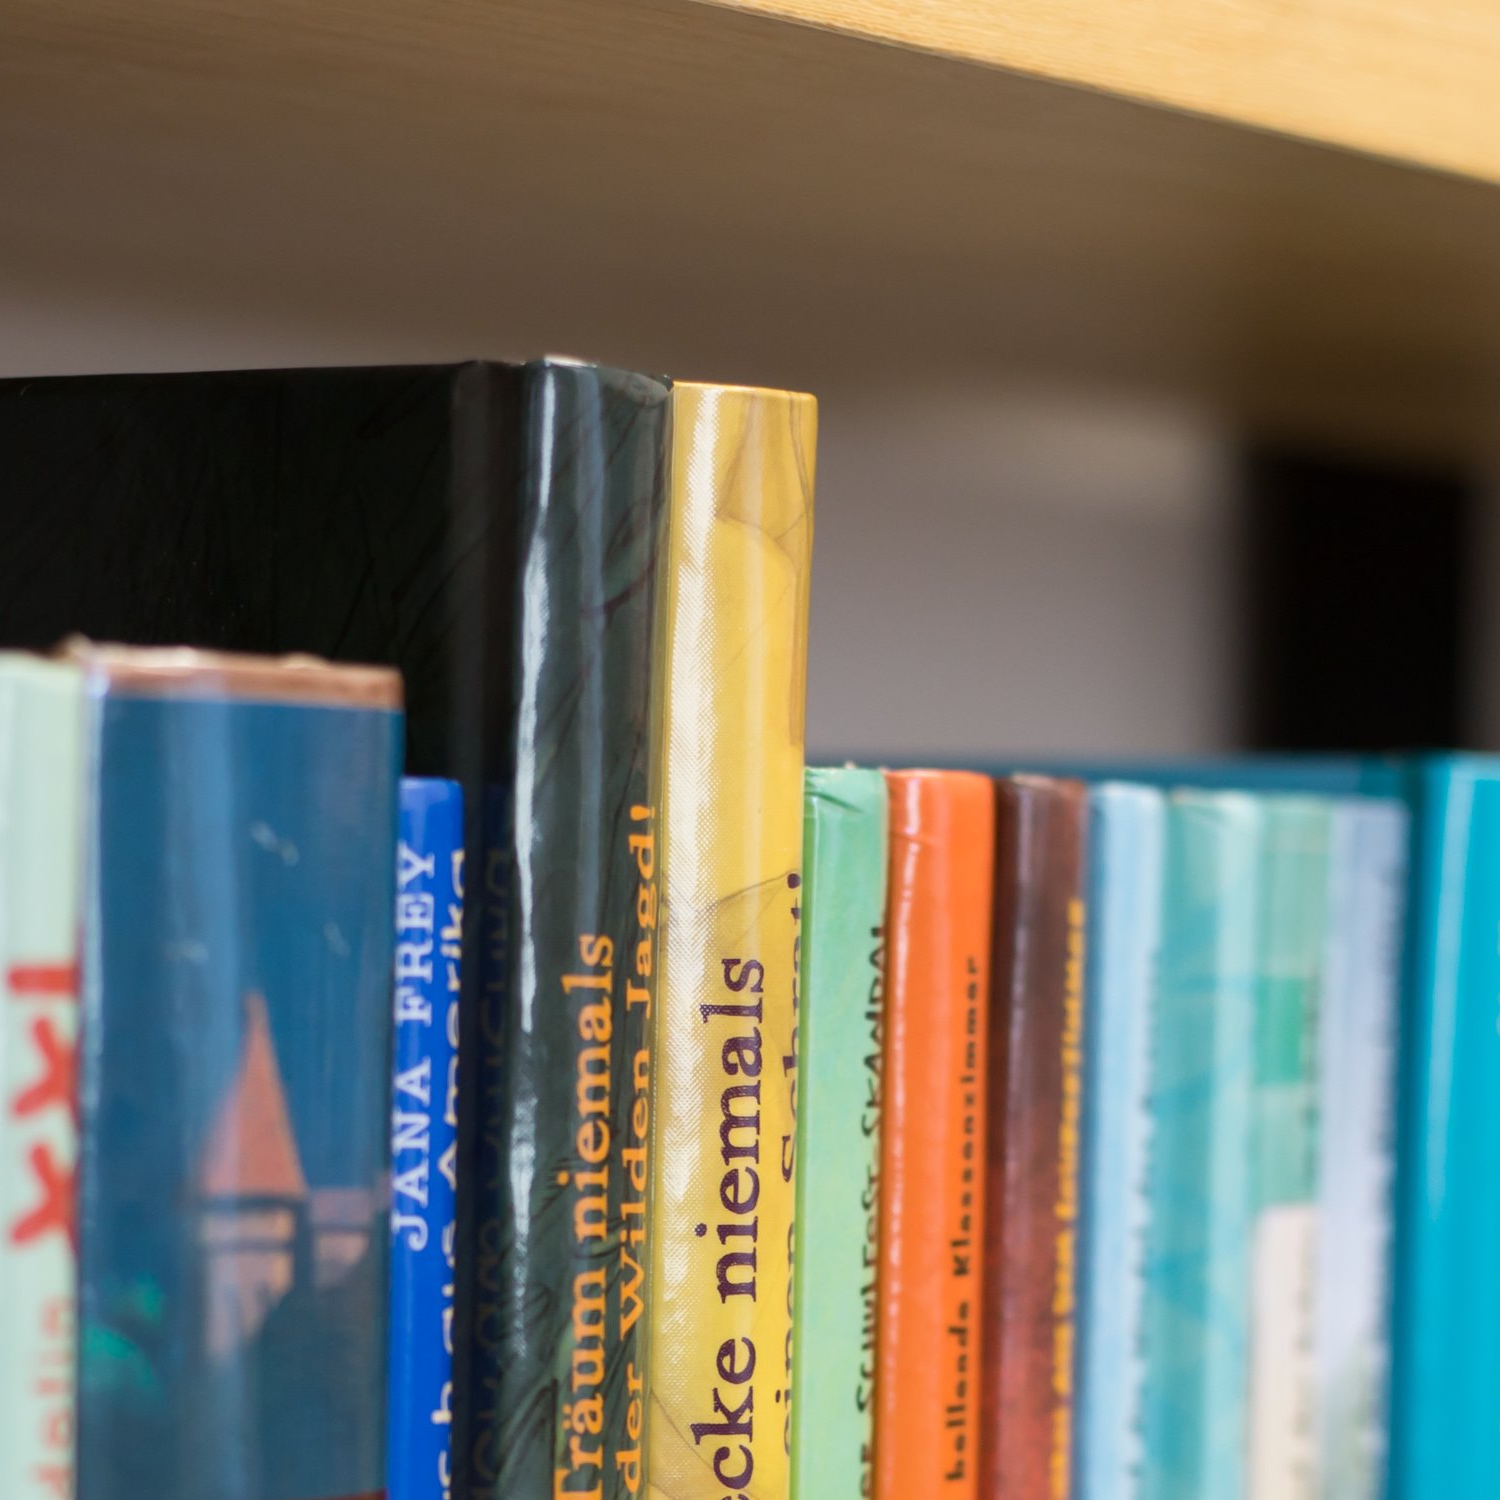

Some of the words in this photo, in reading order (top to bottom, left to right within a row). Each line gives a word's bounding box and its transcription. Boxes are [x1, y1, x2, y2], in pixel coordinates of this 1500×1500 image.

[394, 839, 435, 1027] FREY
[626, 804, 657, 1019] Jagd!
[392, 1057, 433, 1250] JANA
[556, 933, 614, 1245] niemals
[619, 1046, 651, 1341] Wilden
[693, 958, 765, 1305] niemals
[616, 1363, 645, 1494] der
